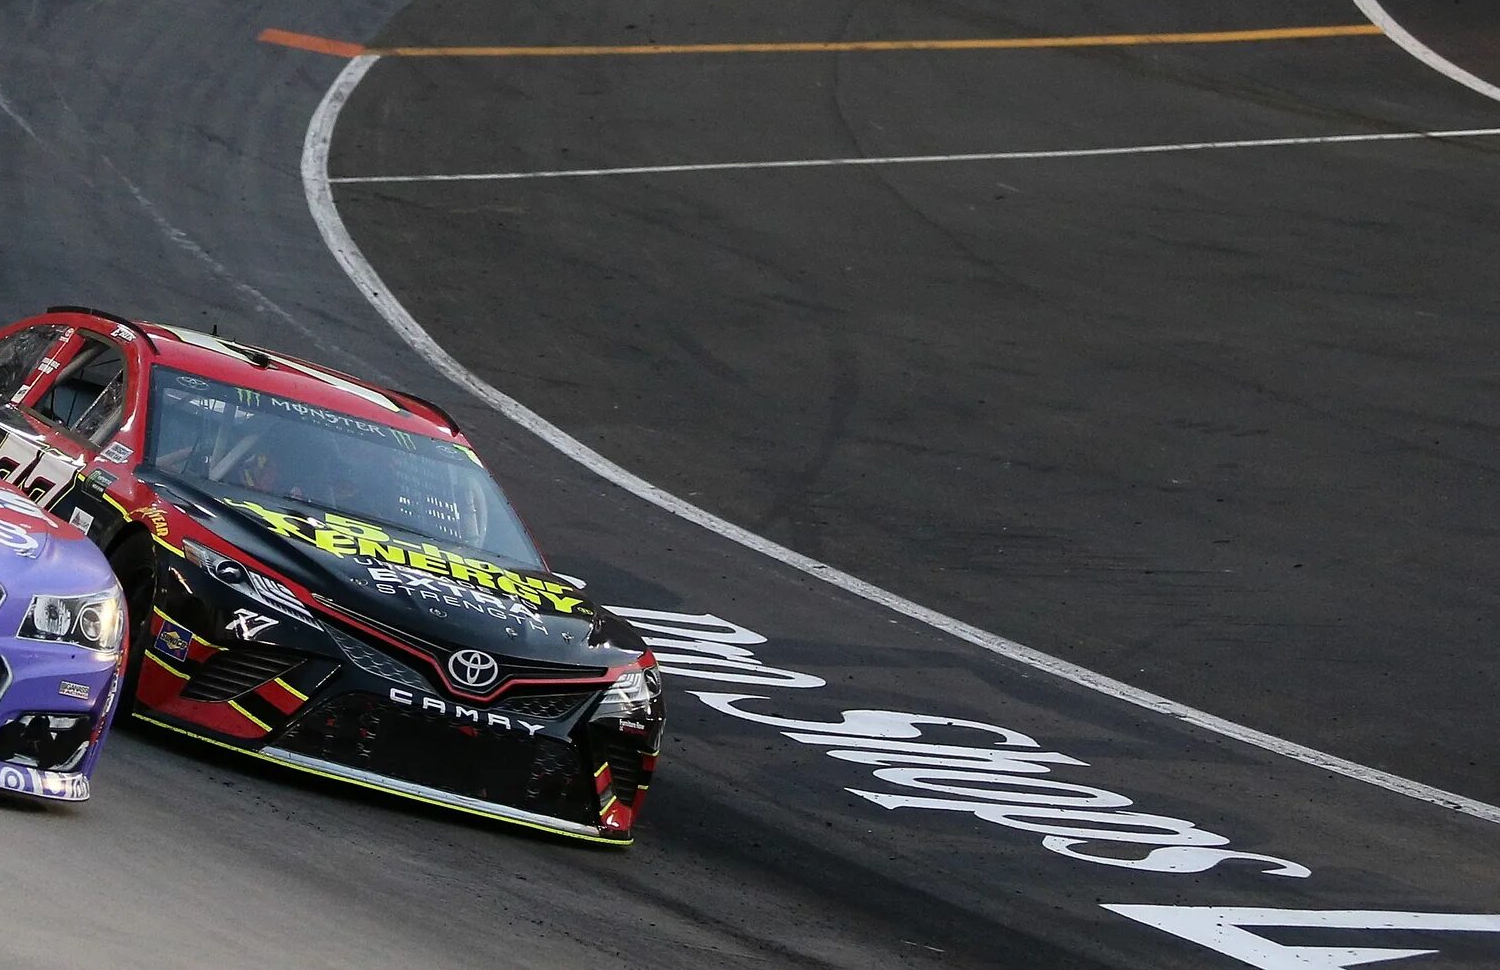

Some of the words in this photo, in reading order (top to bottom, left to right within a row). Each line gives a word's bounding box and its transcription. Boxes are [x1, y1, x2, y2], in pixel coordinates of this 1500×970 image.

[271, 397, 385, 437] MONSTER
[315, 528, 584, 614] ENERGY
[321, 512, 574, 595] 5-hour
[367, 566, 542, 622] EXTRA
[377, 583, 548, 636] STRENGTH
[161, 630, 186, 648] SUNOCO
[226, 609, 279, 639] 77
[389, 687, 545, 735] CAMRY
[686, 690, 1312, 878] Shops
